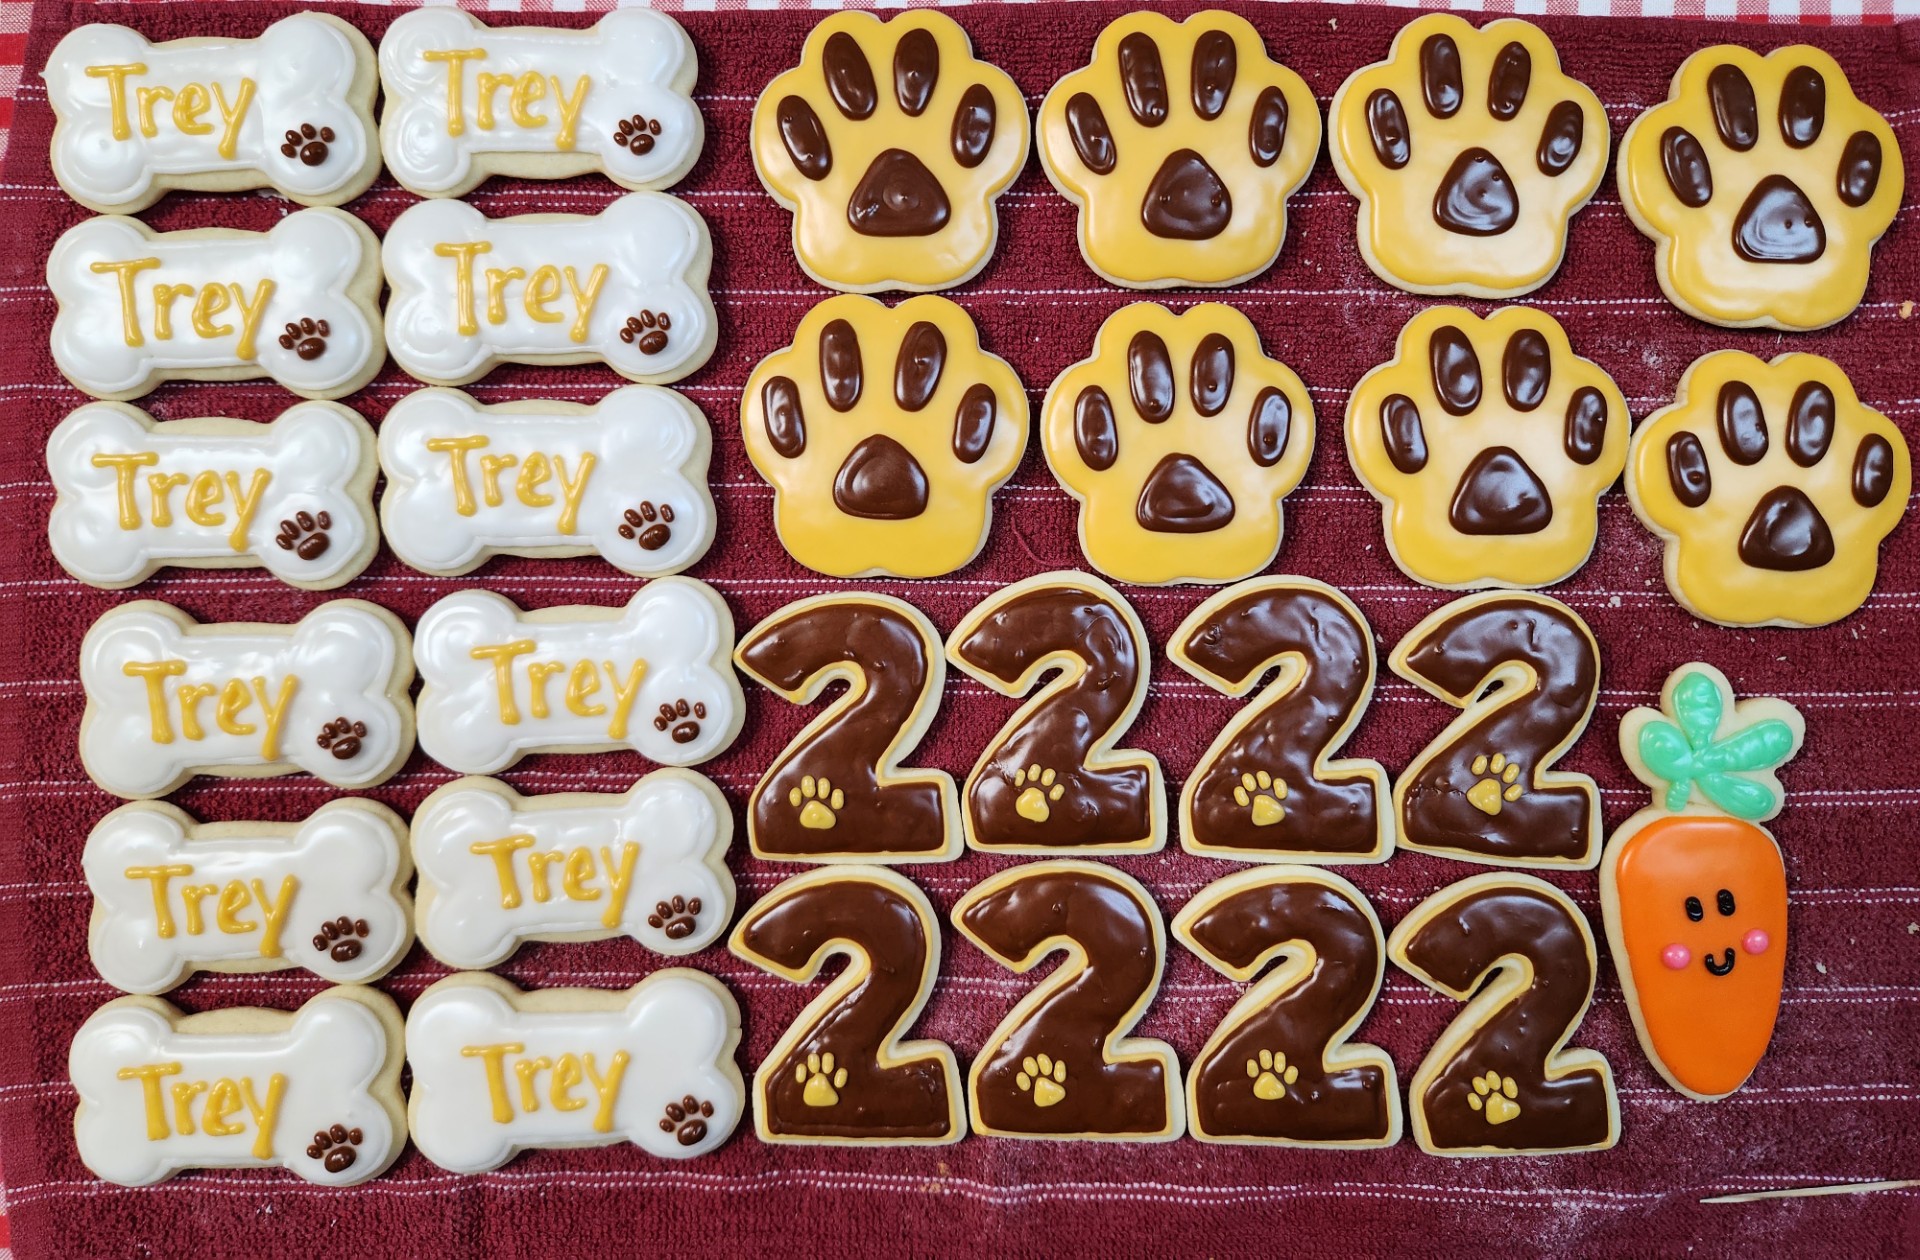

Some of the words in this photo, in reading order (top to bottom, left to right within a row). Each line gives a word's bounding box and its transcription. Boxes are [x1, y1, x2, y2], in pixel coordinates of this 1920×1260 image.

[86, 63, 256, 160] Trey
[425, 48, 590, 152] Trey
[91, 258, 275, 361] Trey
[434, 242, 608, 343] Trey
[92, 452, 271, 553] Trey
[427, 436, 596, 535] Trey
[123, 660, 298, 764] Trey
[470, 640, 647, 740] Trey
[736, 594, 958, 859] 2
[949, 573, 1163, 853] 2
[1170, 578, 1391, 863] 2
[1392, 593, 1598, 867] 2
[125, 864, 298, 960] Trey
[470, 835, 639, 931] Trey
[730, 868, 964, 1143] 2
[953, 865, 1180, 1140] 2
[1175, 868, 1398, 1145] 2
[1391, 876, 1617, 1155] 2
[118, 1062, 287, 1160] Trey
[461, 1043, 630, 1133] Trey
